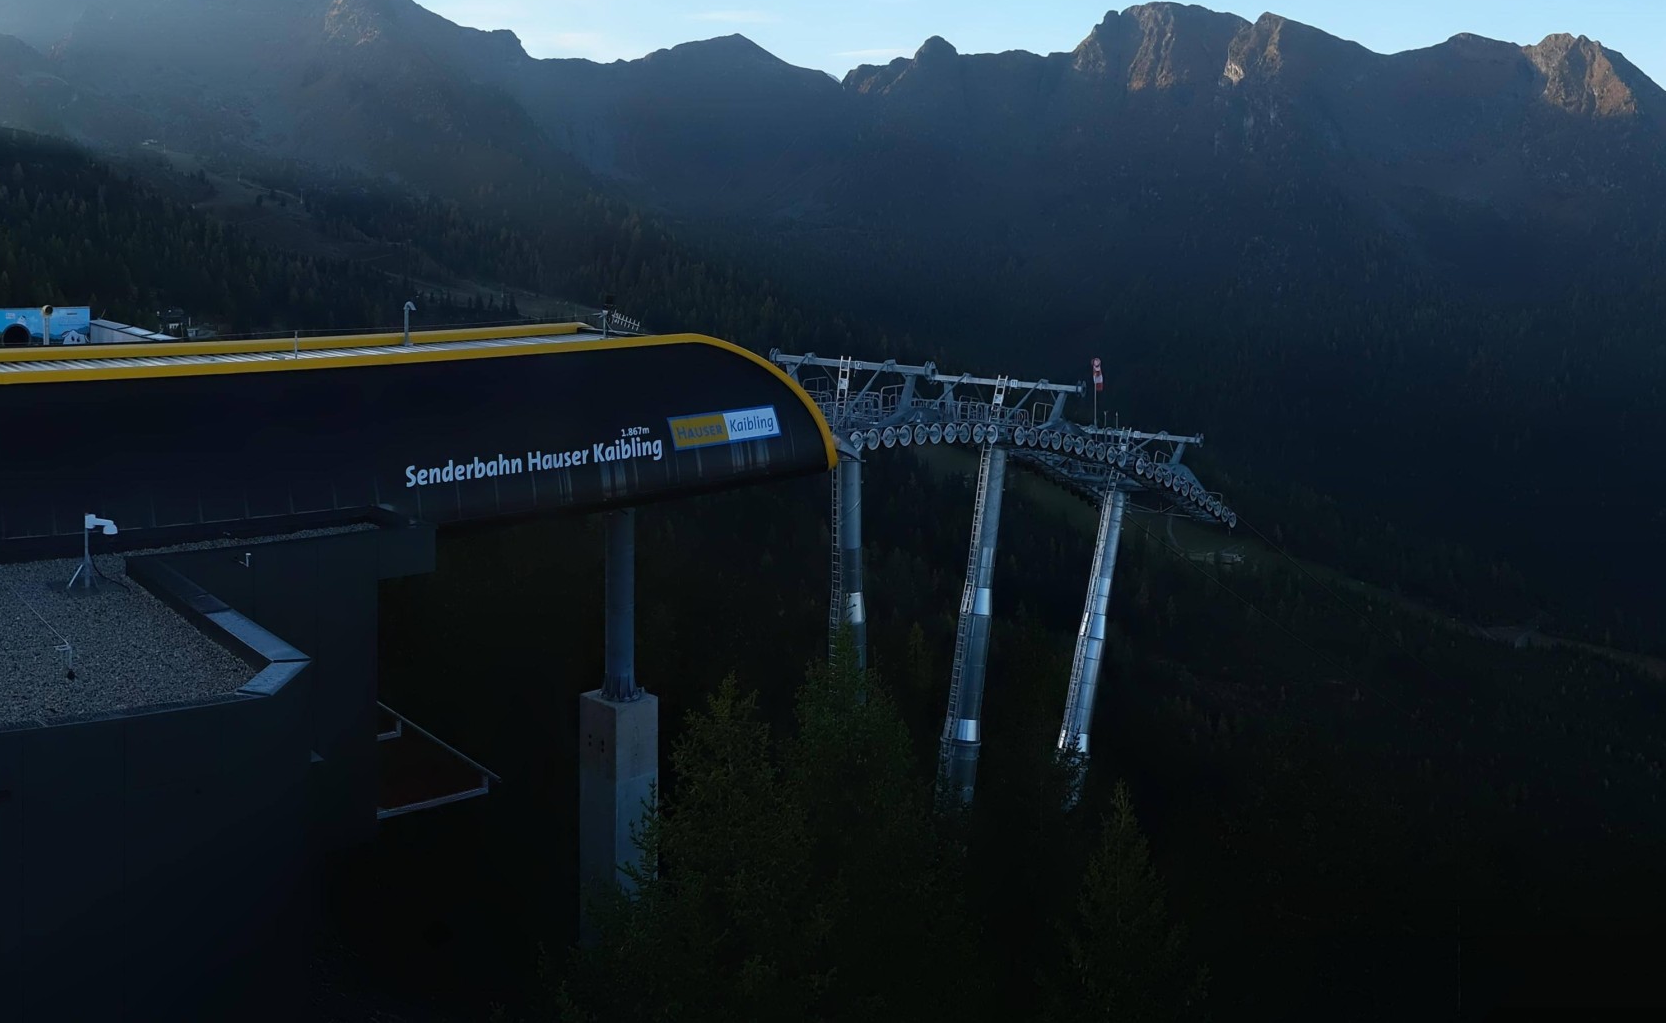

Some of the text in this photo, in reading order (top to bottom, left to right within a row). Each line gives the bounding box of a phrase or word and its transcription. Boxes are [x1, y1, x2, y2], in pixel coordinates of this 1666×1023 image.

[621, 426, 650, 437] 1.867m
[677, 415, 775, 440] HAUSER Kaibling
[405, 436, 663, 488] Senderbahn Hauser Kaibling
